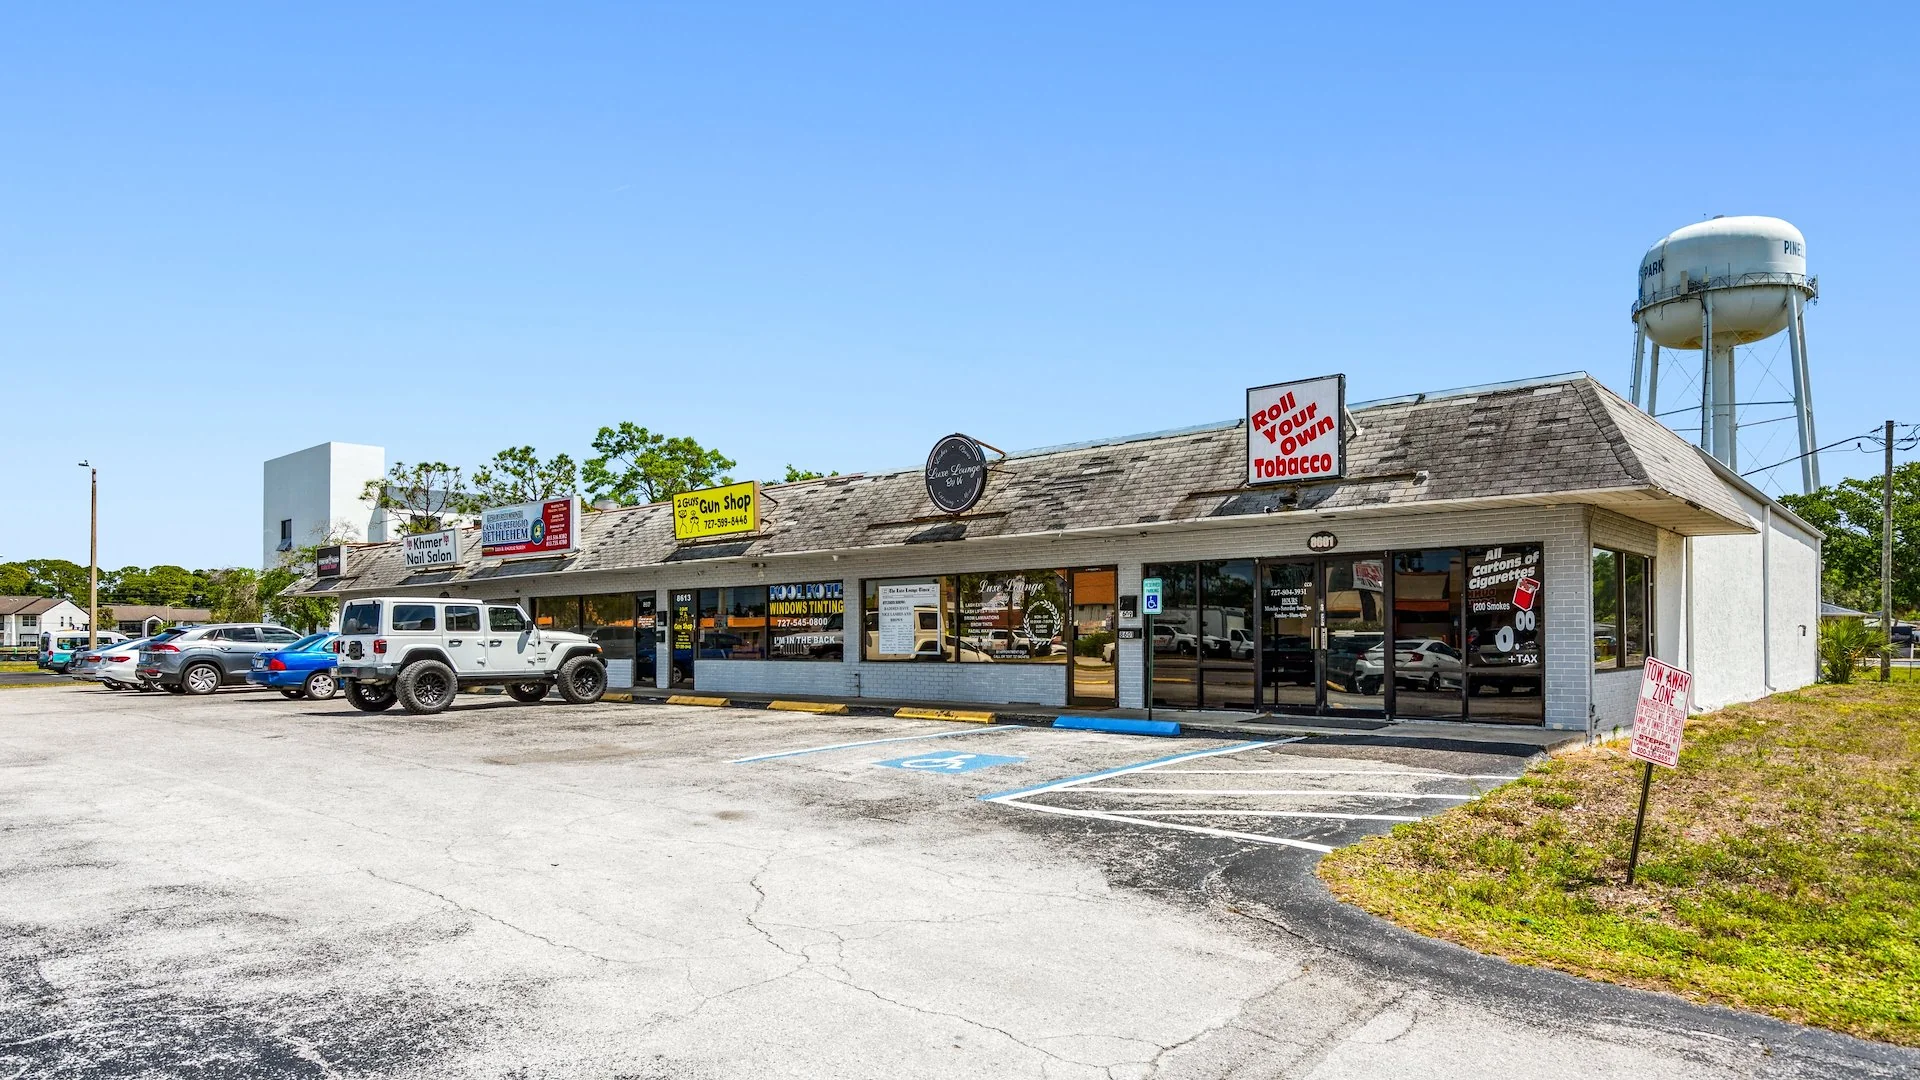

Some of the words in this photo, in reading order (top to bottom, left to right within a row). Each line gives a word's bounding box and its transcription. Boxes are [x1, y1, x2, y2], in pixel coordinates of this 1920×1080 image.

[1644, 258, 1664, 279] PARK
[1251, 391, 1296, 431] Roll
[1262, 402, 1317, 444] Your
[1280, 416, 1334, 455] Own
[927, 468, 949, 480] Luxe
[950, 463, 981, 479] Lounge
[1254, 453, 1332, 478] Tobacco
[677, 499, 682, 509] 2
[699, 498, 720, 514] Gun
[723, 492, 751, 512] Shop
[413, 536, 443, 550] Khmer
[482, 528, 528, 543] BETHLEHEM
[406, 551, 425, 565] Nail
[426, 549, 452, 563] Salon
[1485, 547, 1502, 561] All
[1472, 557, 1522, 577] Cartons
[1524, 550, 1540, 565] of
[1468, 566, 1536, 590] Cigarettes
[769, 584, 805, 600] KOOL
[978, 579, 1002, 593] Luxe
[1006, 578, 1045, 597] Lounge
[676, 594, 691, 602] 8613
[1486, 601, 1511, 611] Smokes
[769, 601, 808, 615] WINDOWS
[809, 600, 844, 614] TINTING
[777, 617, 828, 627] 727-545-0800
[786, 636, 795, 644] IN
[796, 636, 812, 644] THE
[813, 636, 835, 644] BACK
[1647, 661, 1665, 683] TOW
[1665, 670, 1689, 692] AWAY
[1652, 683, 1676, 707] ZONE
